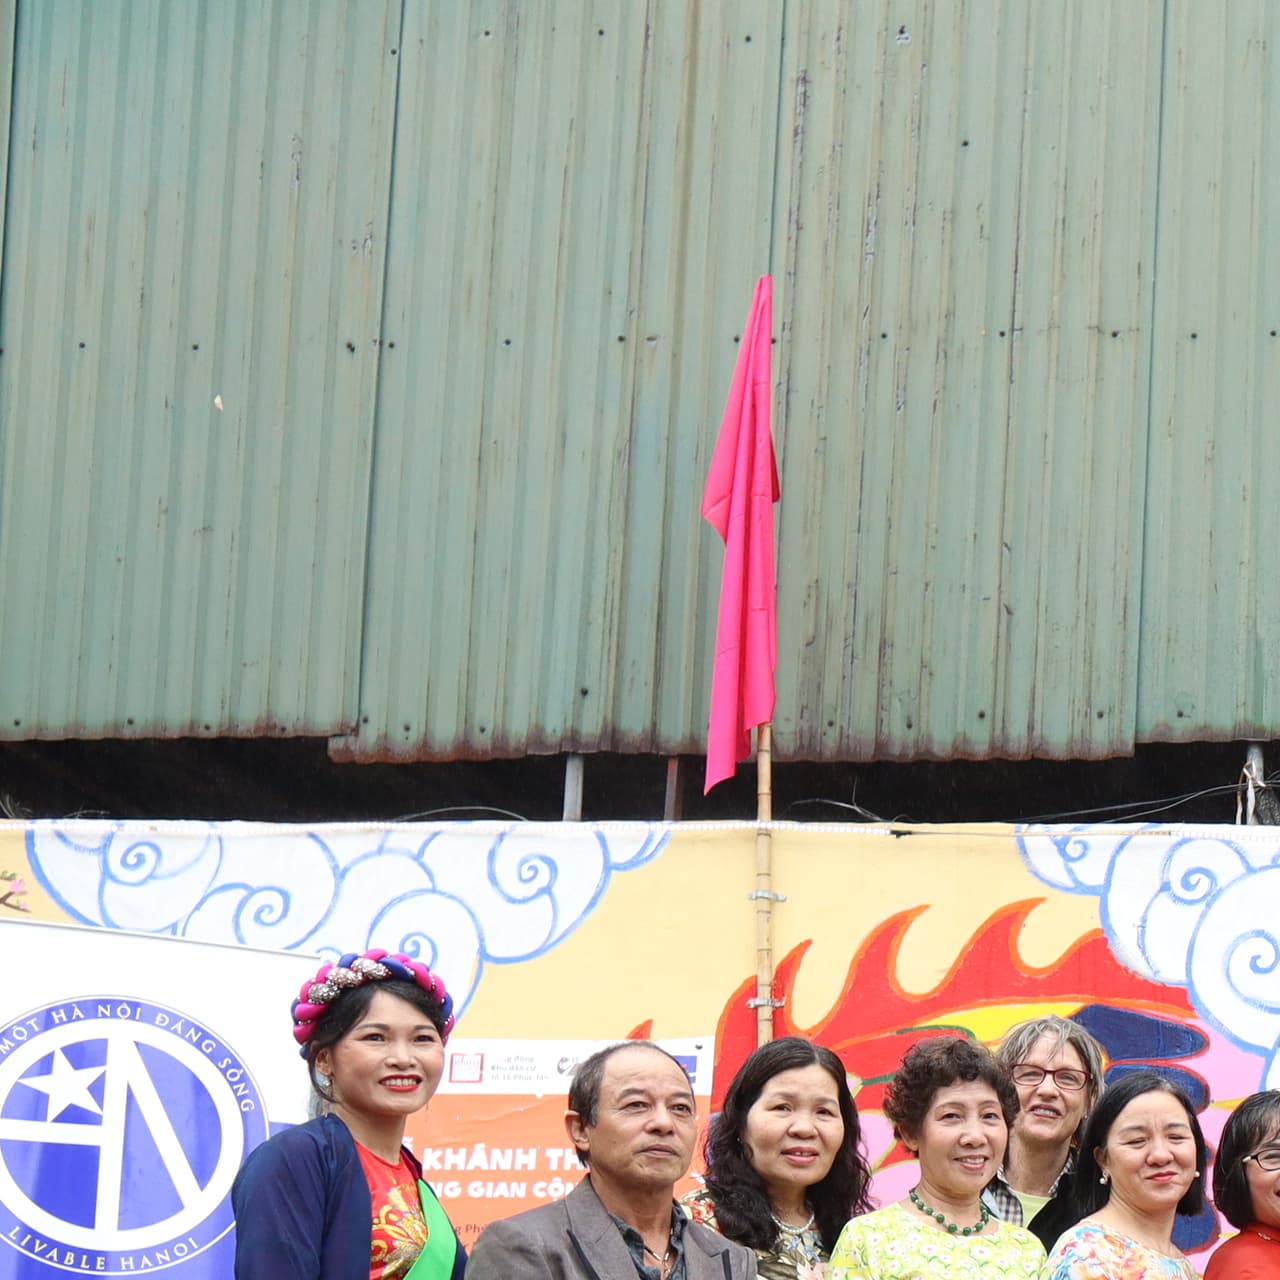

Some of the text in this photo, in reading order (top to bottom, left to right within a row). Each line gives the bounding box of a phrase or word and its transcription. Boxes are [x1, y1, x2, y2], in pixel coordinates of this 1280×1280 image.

[51, 1003, 85, 1024] HÀ
[97, 1002, 142, 1020] NỘI
[423, 1143, 537, 1171] KHÁNH
[467, 1181, 527, 1198] GIAN
[8, 1226, 199, 1270] LIVABLE HANOI
